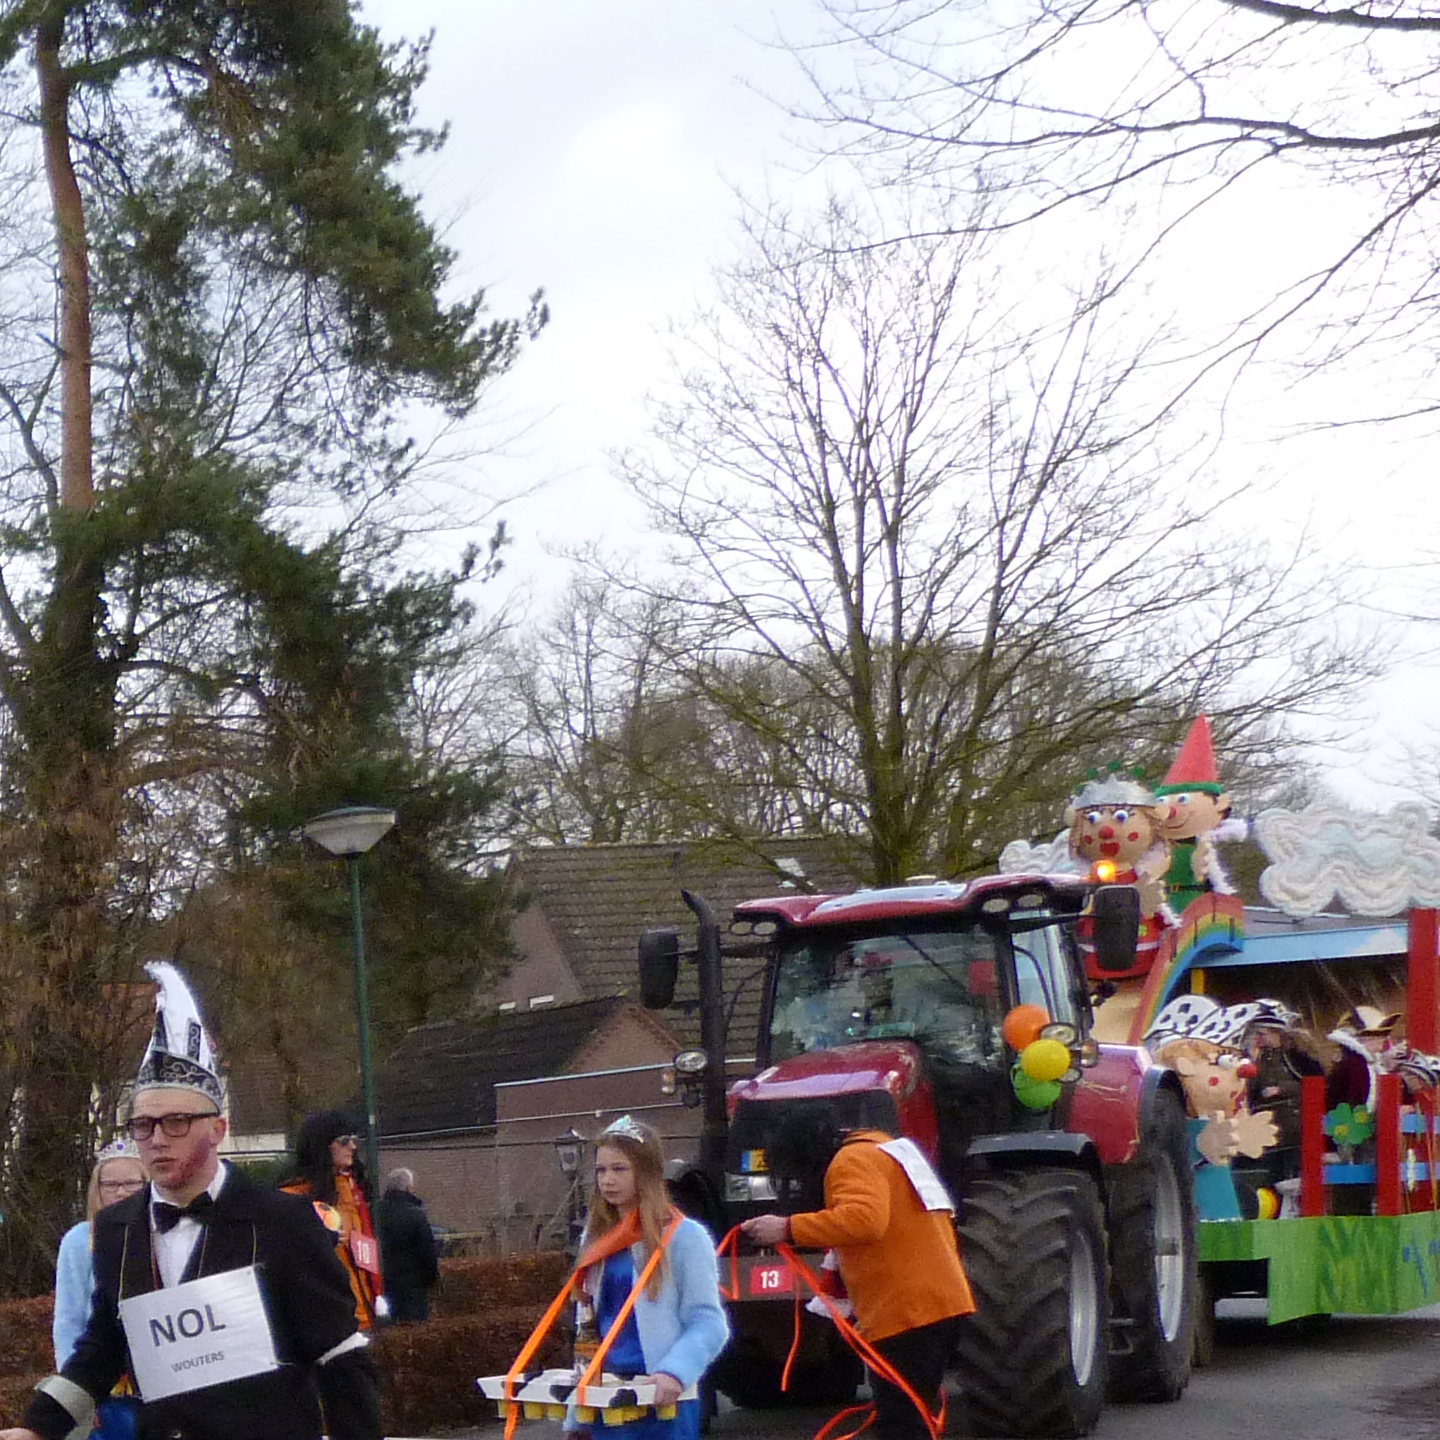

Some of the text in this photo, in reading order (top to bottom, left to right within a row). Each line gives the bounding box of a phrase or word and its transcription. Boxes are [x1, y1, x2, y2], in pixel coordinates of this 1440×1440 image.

[357, 1240, 371, 1264] 10
[761, 1270, 780, 1289] 13
[149, 1304, 226, 1347] NOL
[171, 1351, 225, 1373] WOUTERS
